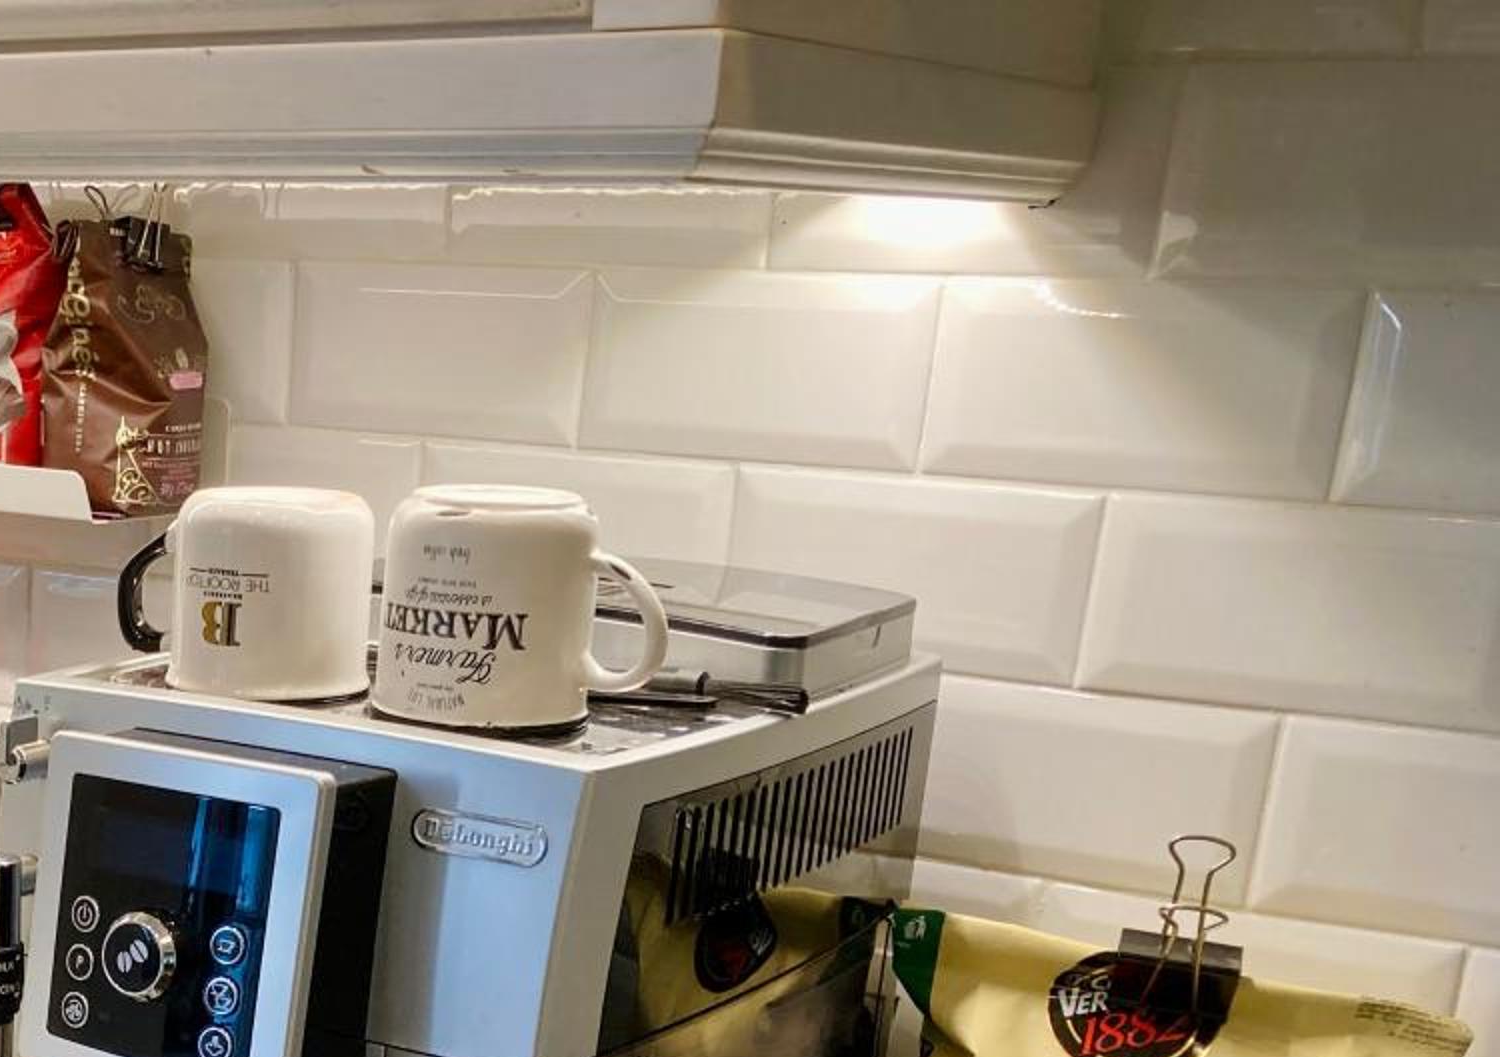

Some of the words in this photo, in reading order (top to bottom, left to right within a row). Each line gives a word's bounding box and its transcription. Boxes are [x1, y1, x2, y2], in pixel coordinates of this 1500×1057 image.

[201, 600, 242, 647] B
[385, 602, 529, 651] MARKET
[395, 643, 496, 685] Farmer's
